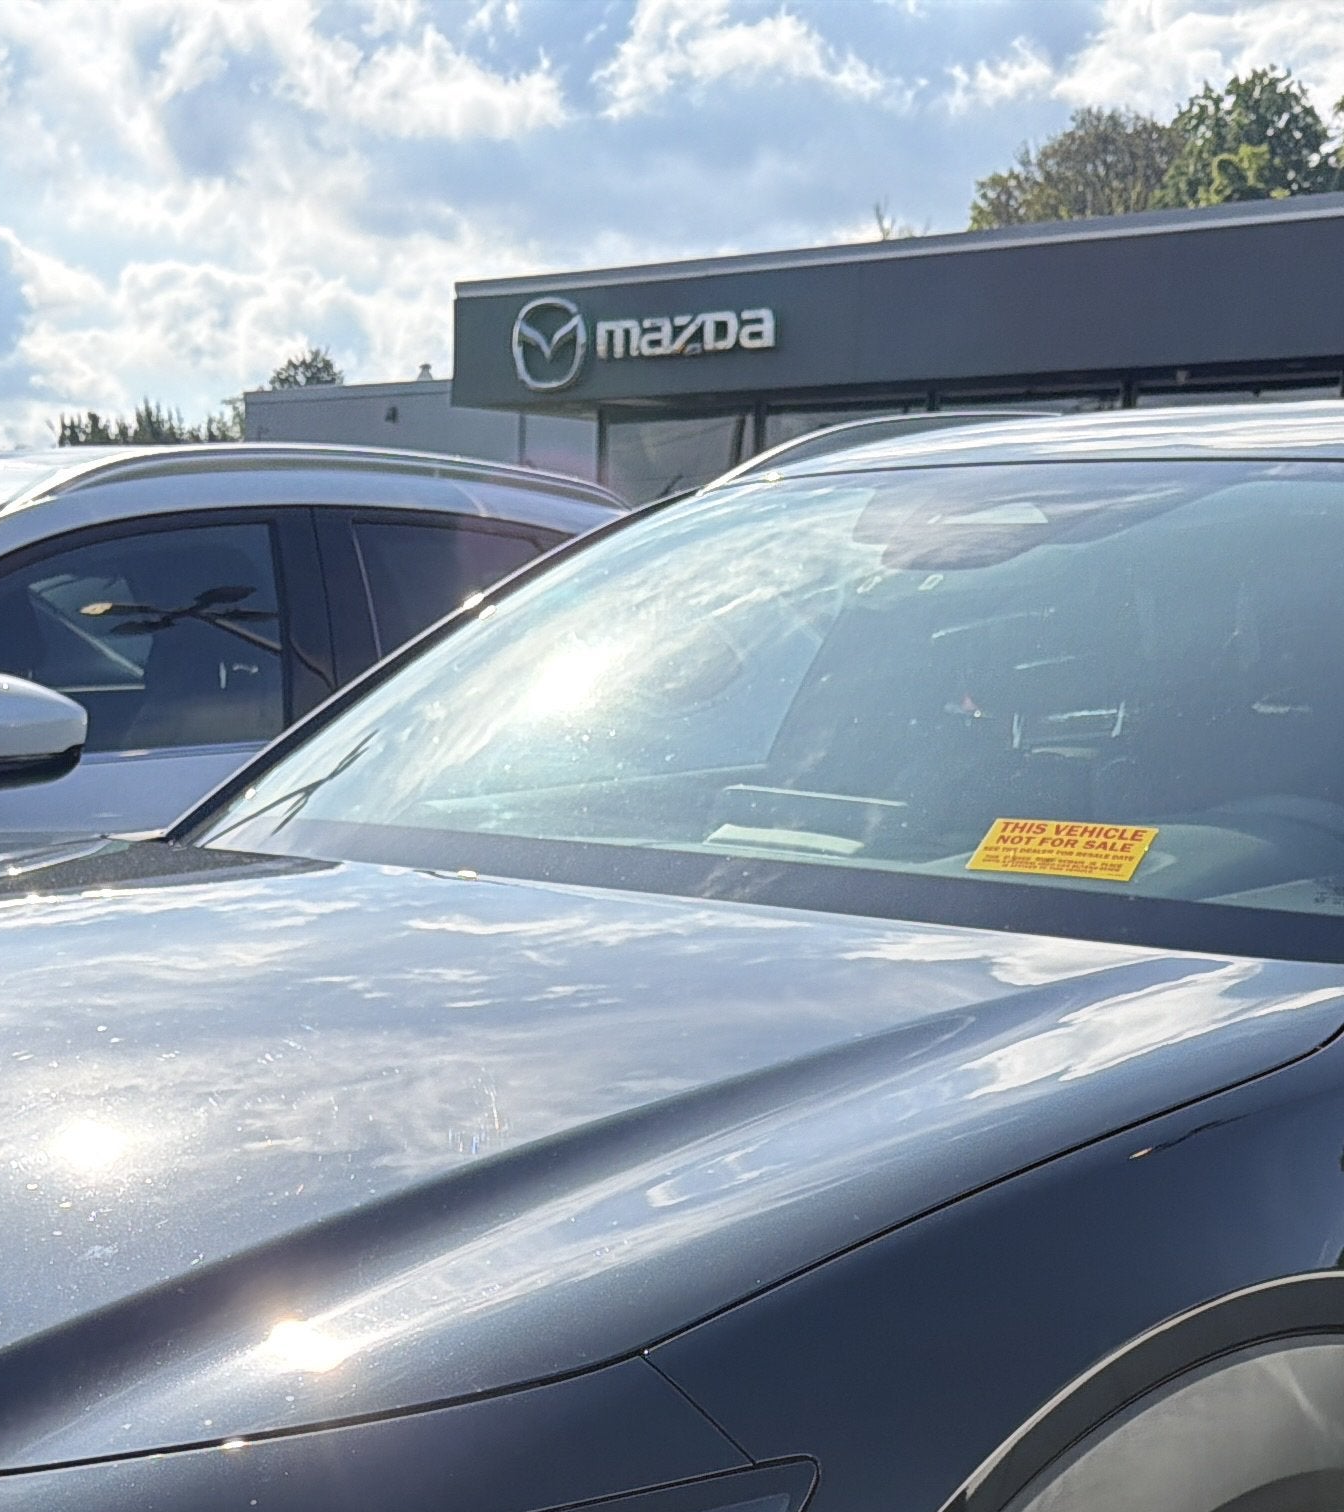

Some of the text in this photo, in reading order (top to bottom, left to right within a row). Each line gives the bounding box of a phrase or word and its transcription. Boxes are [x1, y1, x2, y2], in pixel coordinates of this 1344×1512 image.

[596, 308, 775, 358] mazda
[1000, 821, 1147, 842] THIS VEHICLE
[996, 835, 1134, 853] NOT FOR SALE
